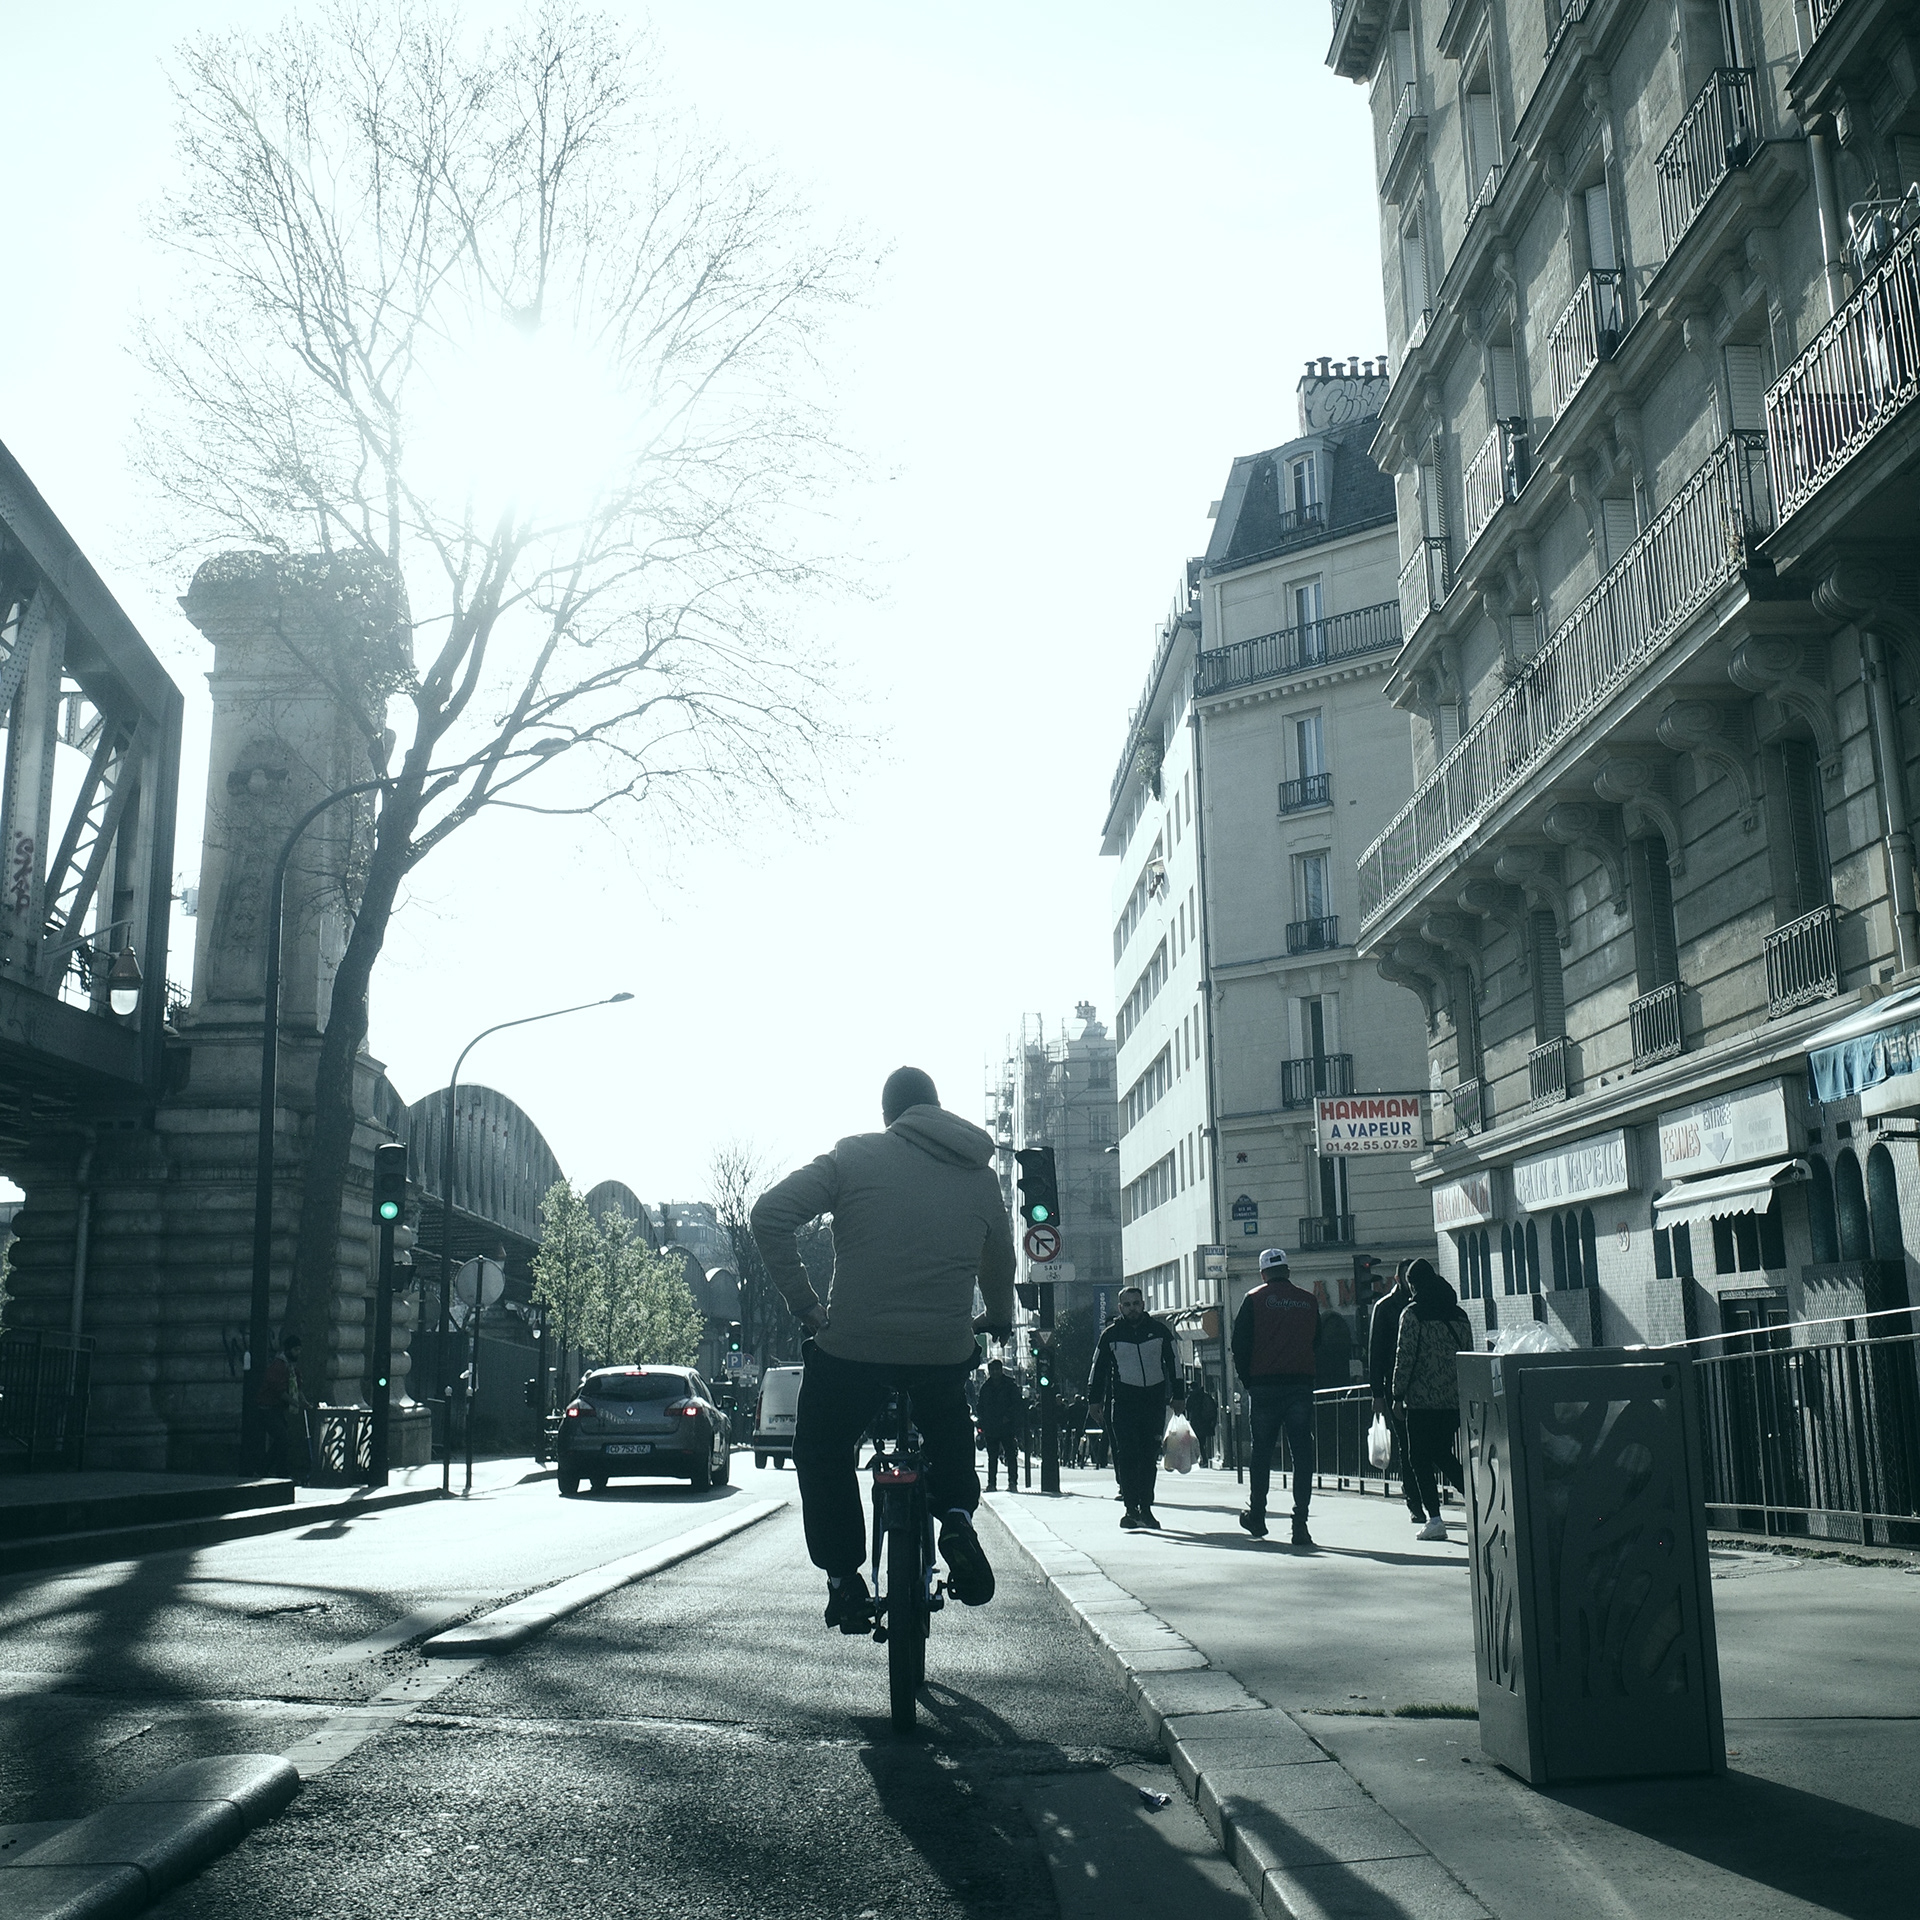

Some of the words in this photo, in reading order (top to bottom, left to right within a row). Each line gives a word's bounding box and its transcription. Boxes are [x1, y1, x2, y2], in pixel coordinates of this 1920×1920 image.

[1320, 1098, 1419, 1121] HAMMAM
[1331, 1124, 1341, 1138] A
[1347, 1121, 1412, 1138] VAPEUR
[1326, 1139, 1418, 1152] 01.42.55.07.92
[1662, 1122, 1701, 1164] FEMMES
[1516, 1161, 1549, 1205] BAIN
[1564, 1140, 1626, 1194] VAPEUR
[1099, 1292, 1107, 1324] Voyages
[731, 1355, 739, 1367] P
